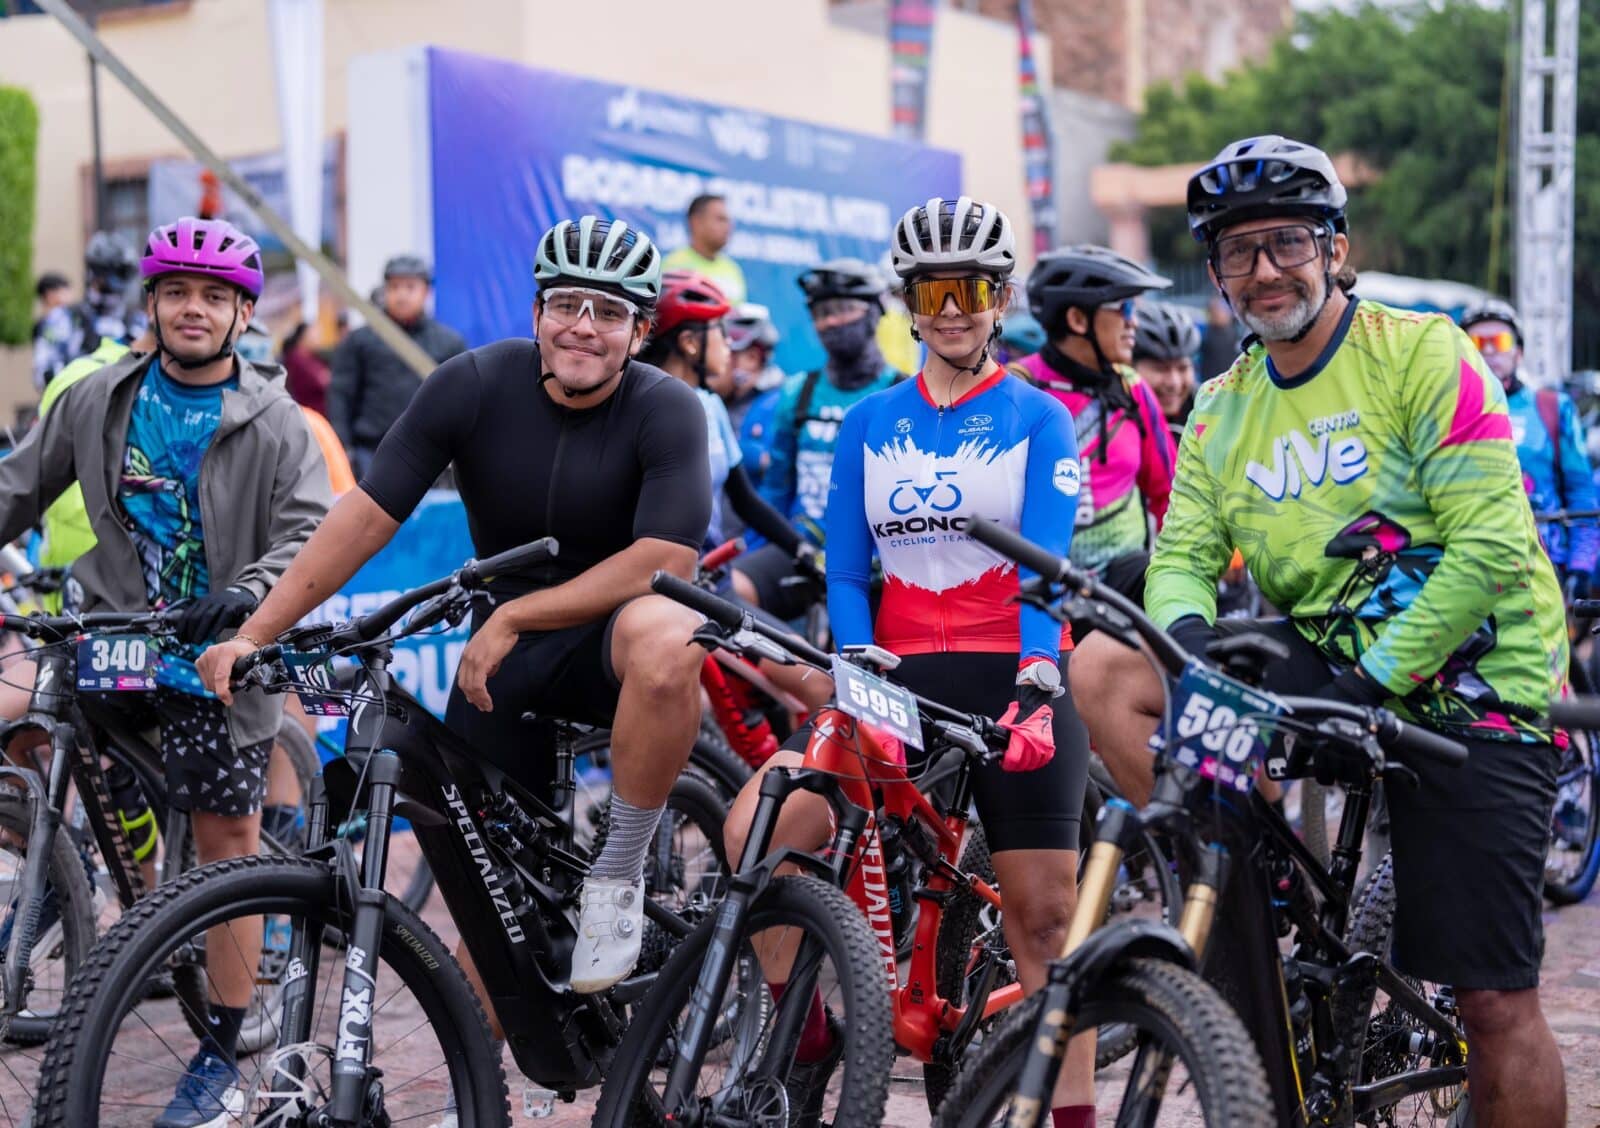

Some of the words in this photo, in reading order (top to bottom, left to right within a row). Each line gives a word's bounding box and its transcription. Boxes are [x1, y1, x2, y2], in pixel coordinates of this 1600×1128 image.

[957, 425, 994, 435] SUBARU
[890, 536, 936, 548] CYCLING
[91, 639, 146, 672] 340
[848, 677, 909, 728] 595
[1176, 691, 1259, 762] 596
[441, 783, 526, 944] SPECIALIZED
[392, 921, 440, 970] SPECIALIZED
[335, 986, 372, 1062] FOX
